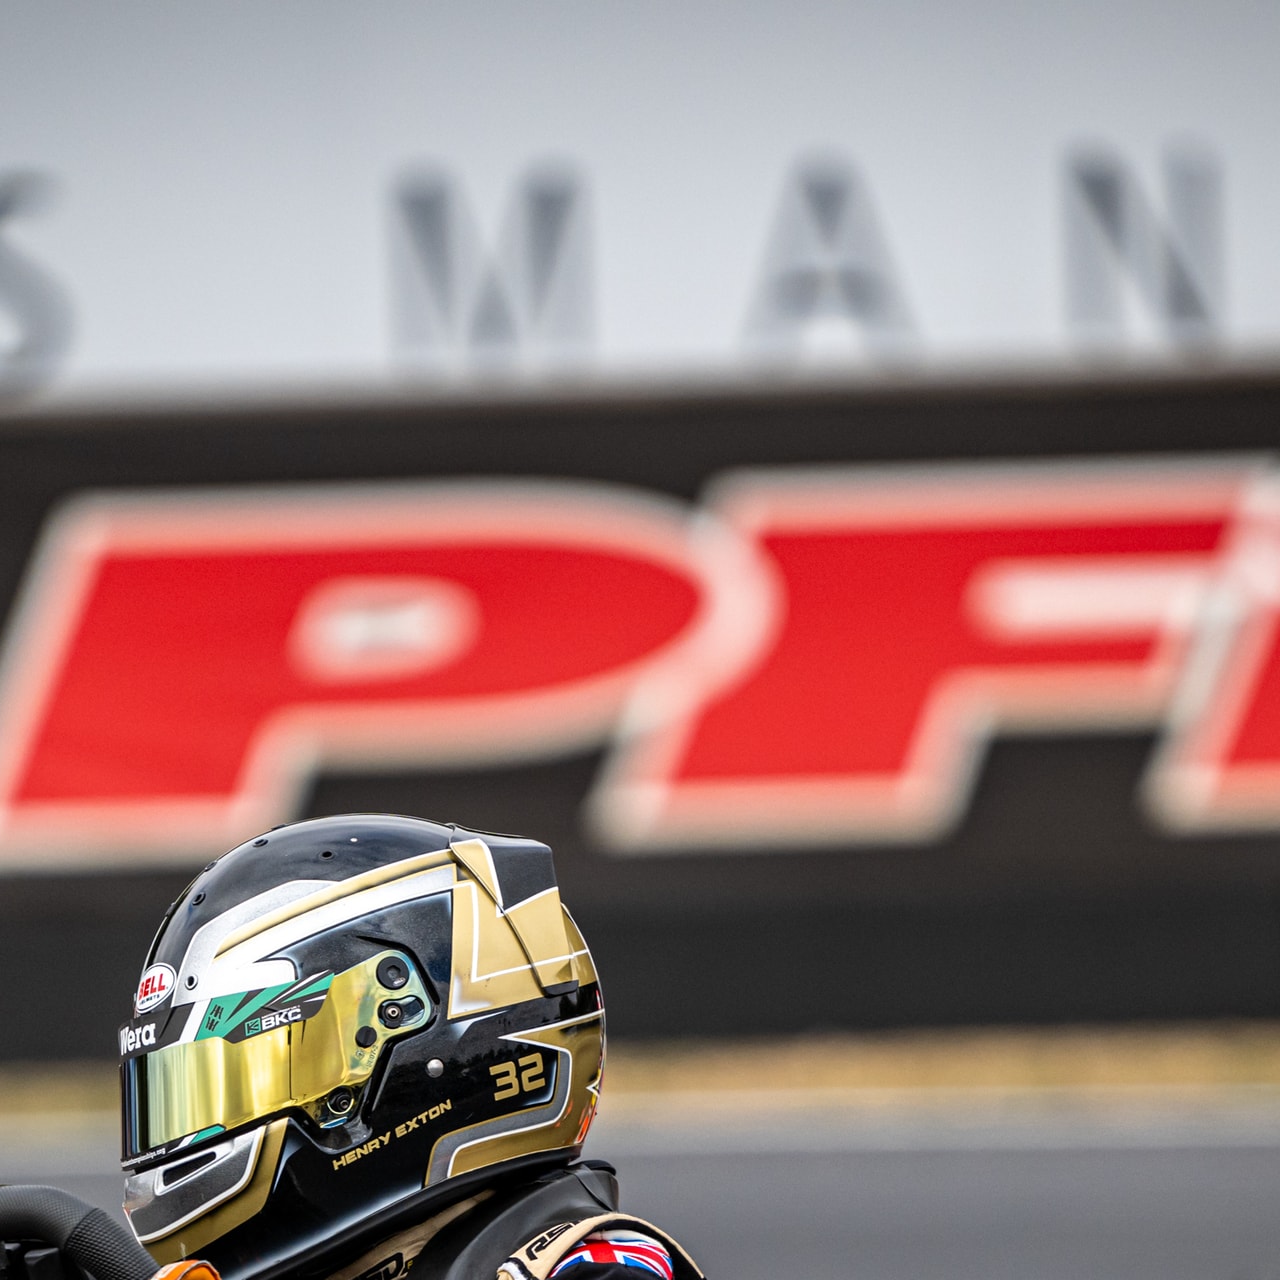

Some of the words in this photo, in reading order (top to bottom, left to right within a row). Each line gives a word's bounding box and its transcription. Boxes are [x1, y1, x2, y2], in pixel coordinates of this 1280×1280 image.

[138, 973, 166, 997] BELL
[261, 1008, 302, 1031] BKC
[120, 1023, 156, 1055] Wera
[489, 1052, 546, 1101] 32
[332, 1131, 391, 1171] HENRY
[395, 1098, 453, 1139] EXTON
[526, 1222, 577, 1261] RS
